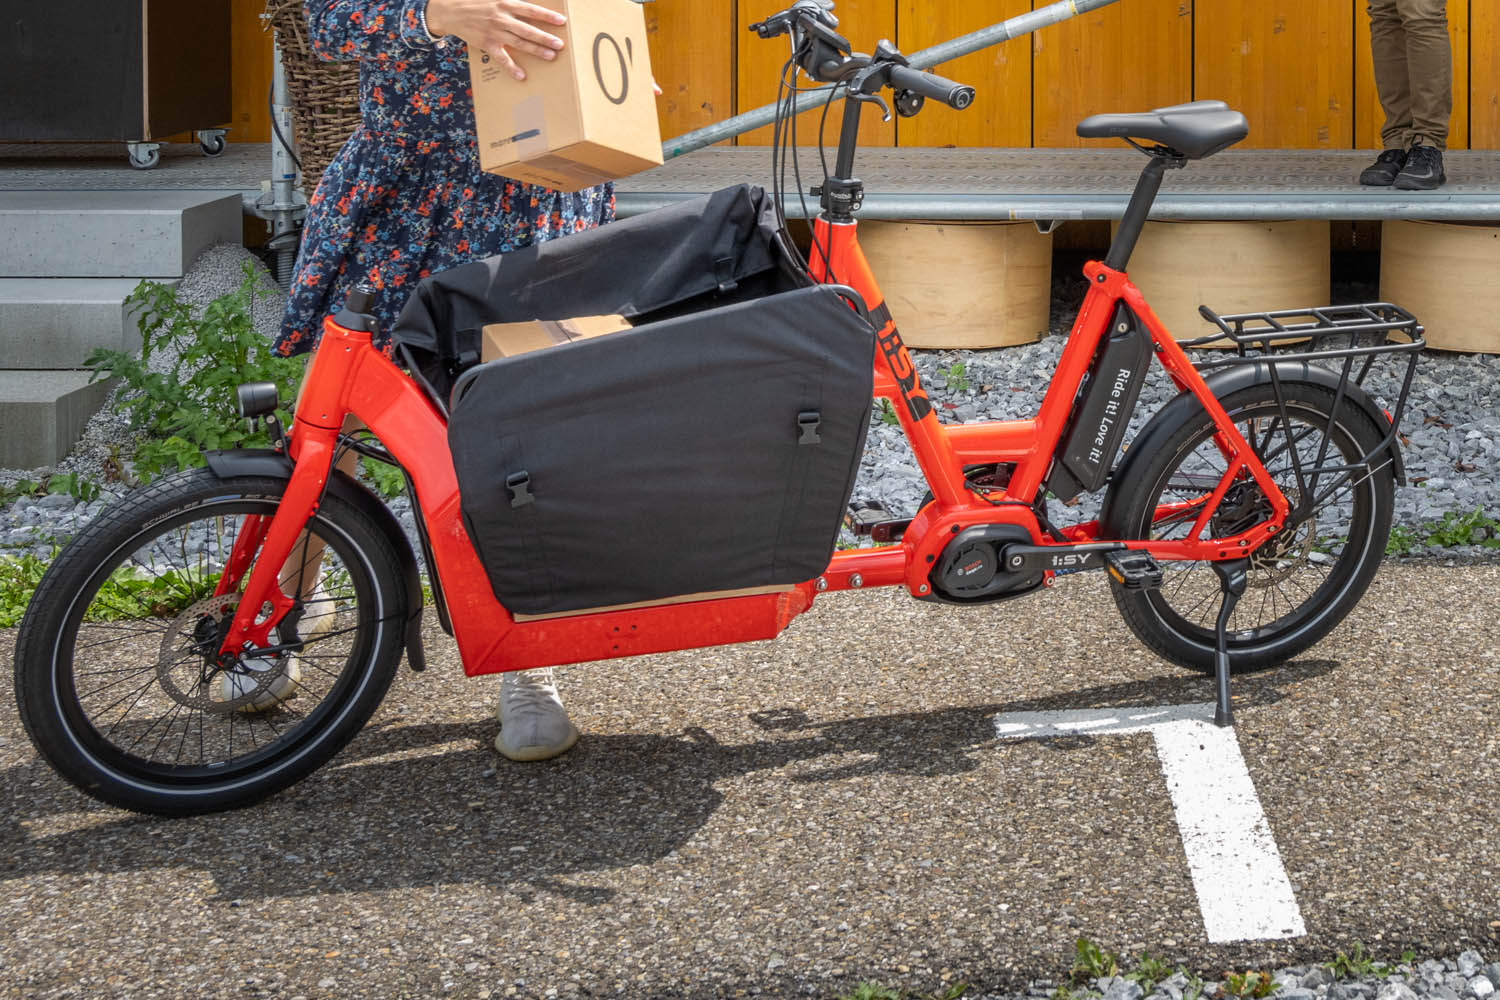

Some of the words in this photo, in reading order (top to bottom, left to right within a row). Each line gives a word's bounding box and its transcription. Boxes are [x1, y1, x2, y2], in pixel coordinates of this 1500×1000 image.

[1111, 368, 1131, 398] Ride
[1105, 400, 1120, 415] it!
[1094, 417, 1113, 446] Love
[1088, 447, 1103, 464] it!
